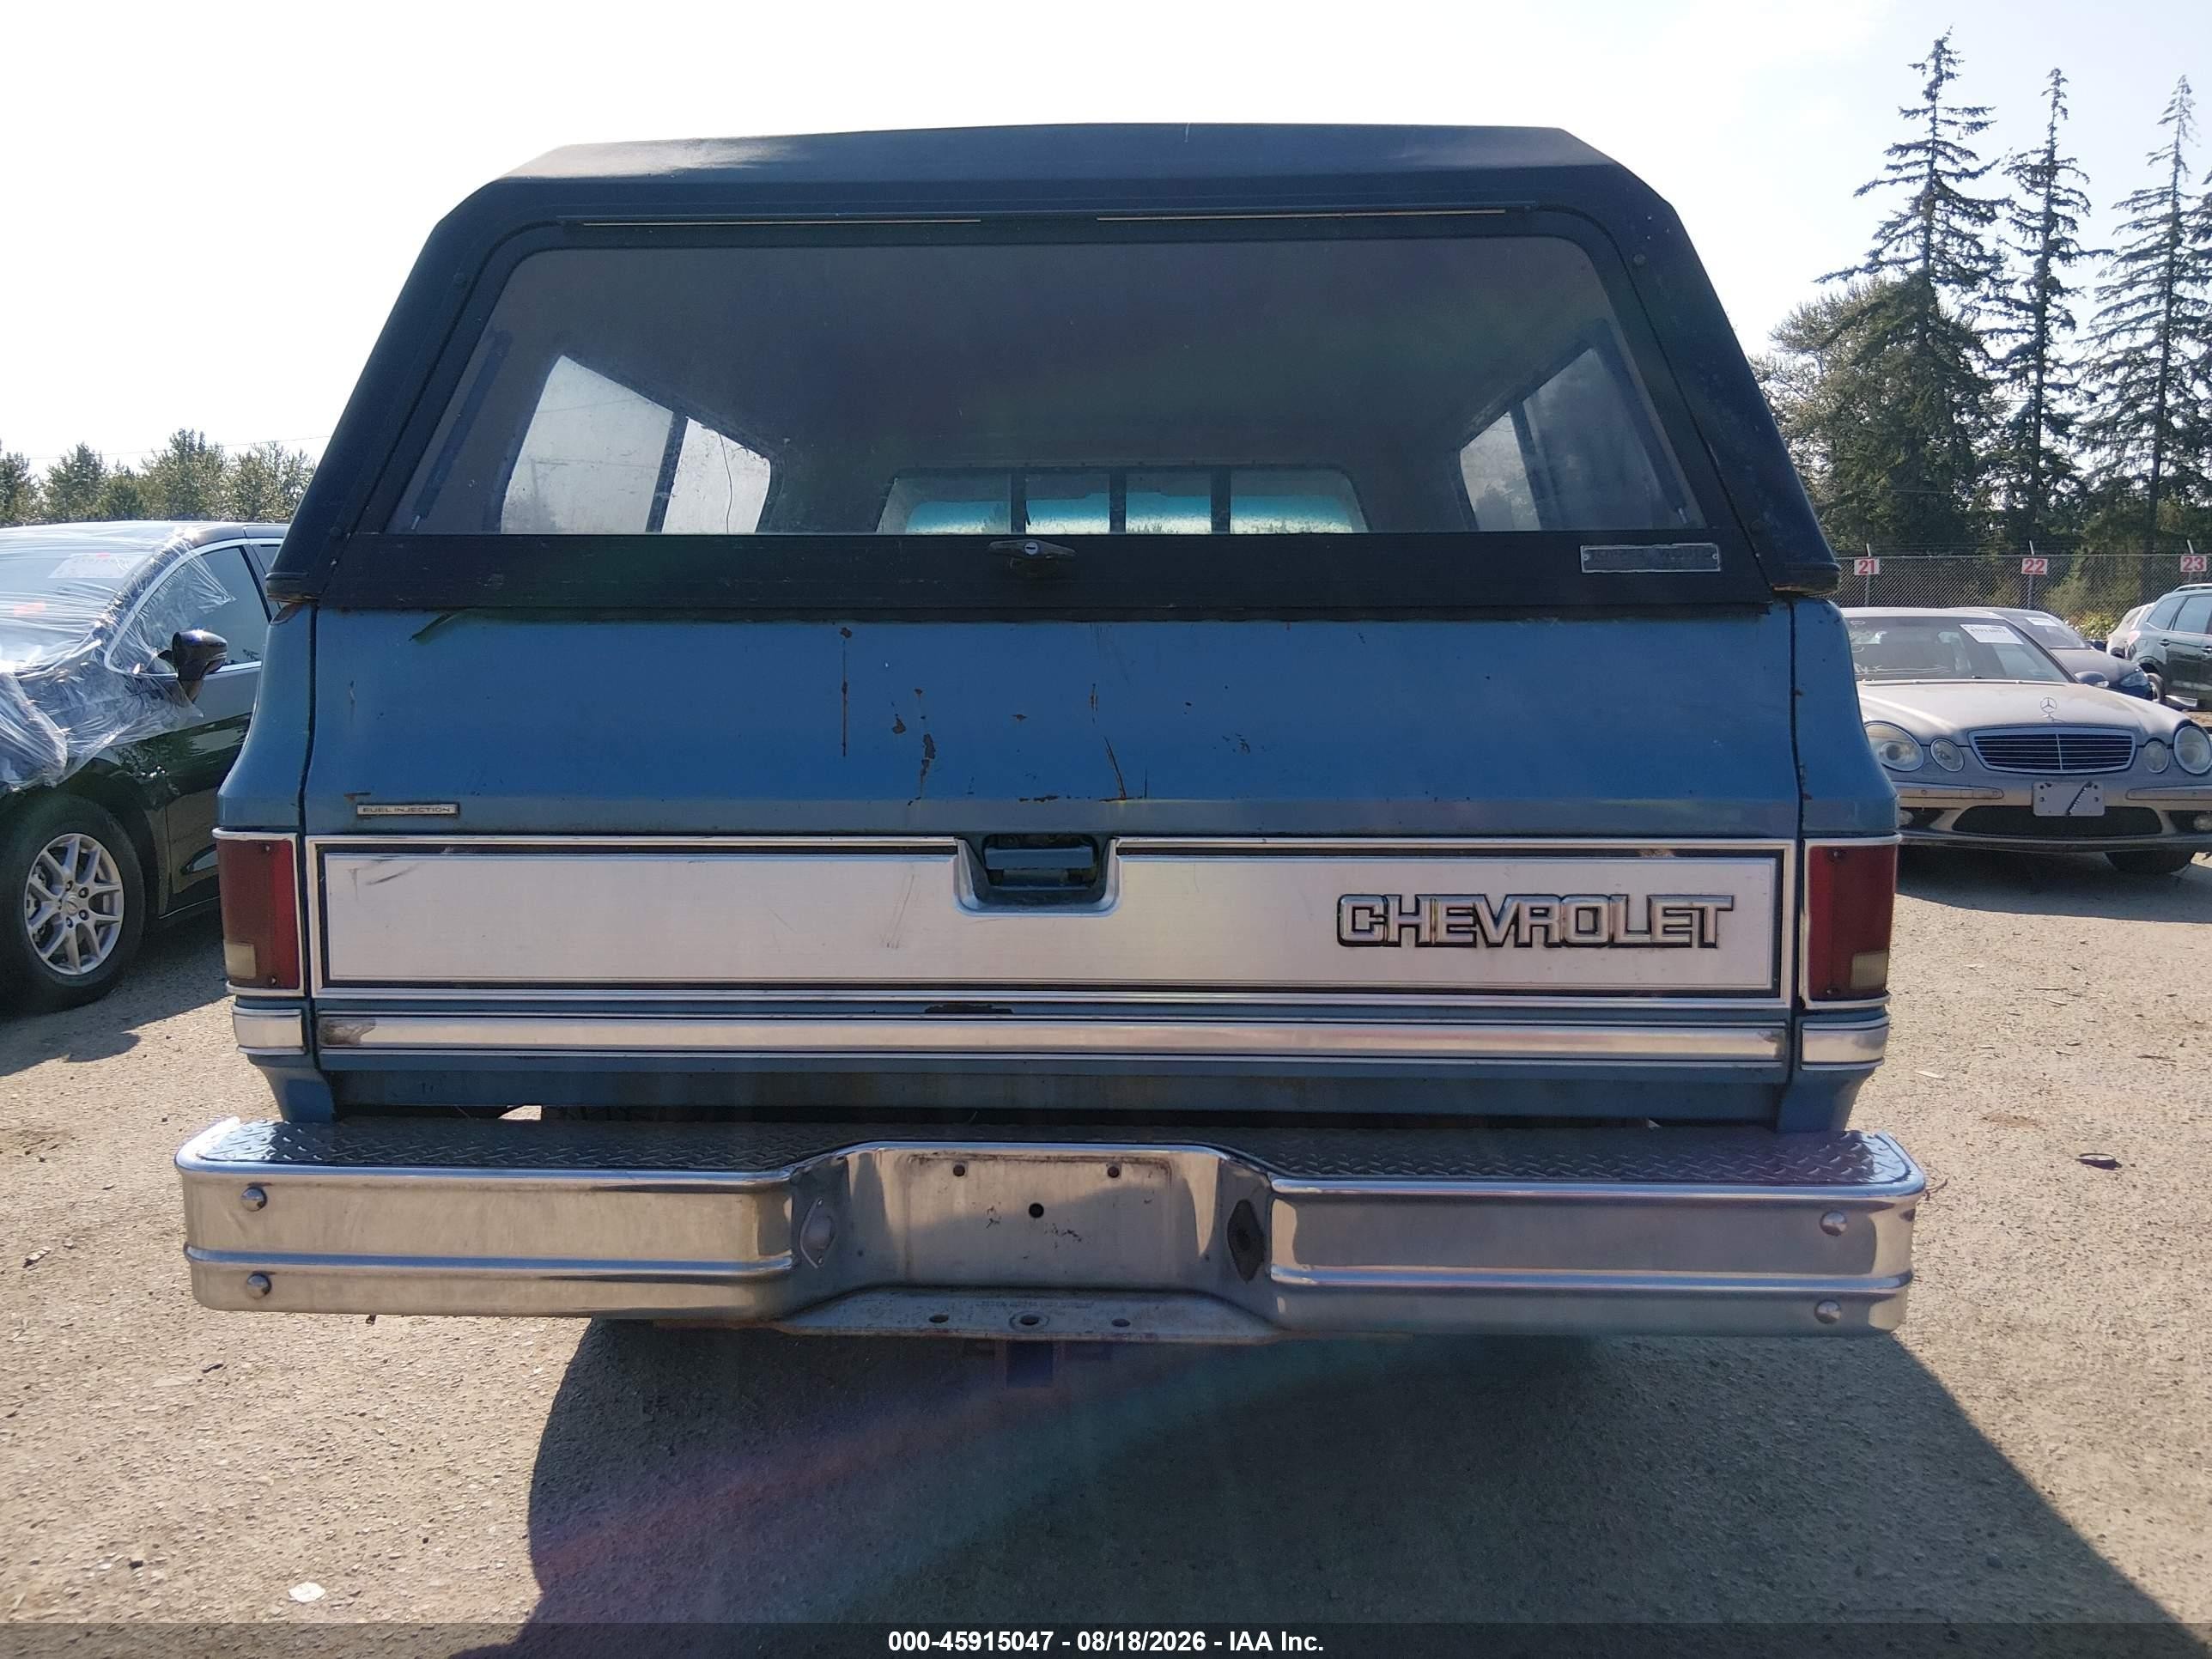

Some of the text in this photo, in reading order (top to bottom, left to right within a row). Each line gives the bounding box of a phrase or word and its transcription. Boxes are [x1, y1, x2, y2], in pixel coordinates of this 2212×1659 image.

[1858, 559, 1875, 574] 21
[2024, 559, 2045, 574] 22
[2183, 556, 2204, 571] 23
[1337, 893, 1734, 948] CHEVROLET
